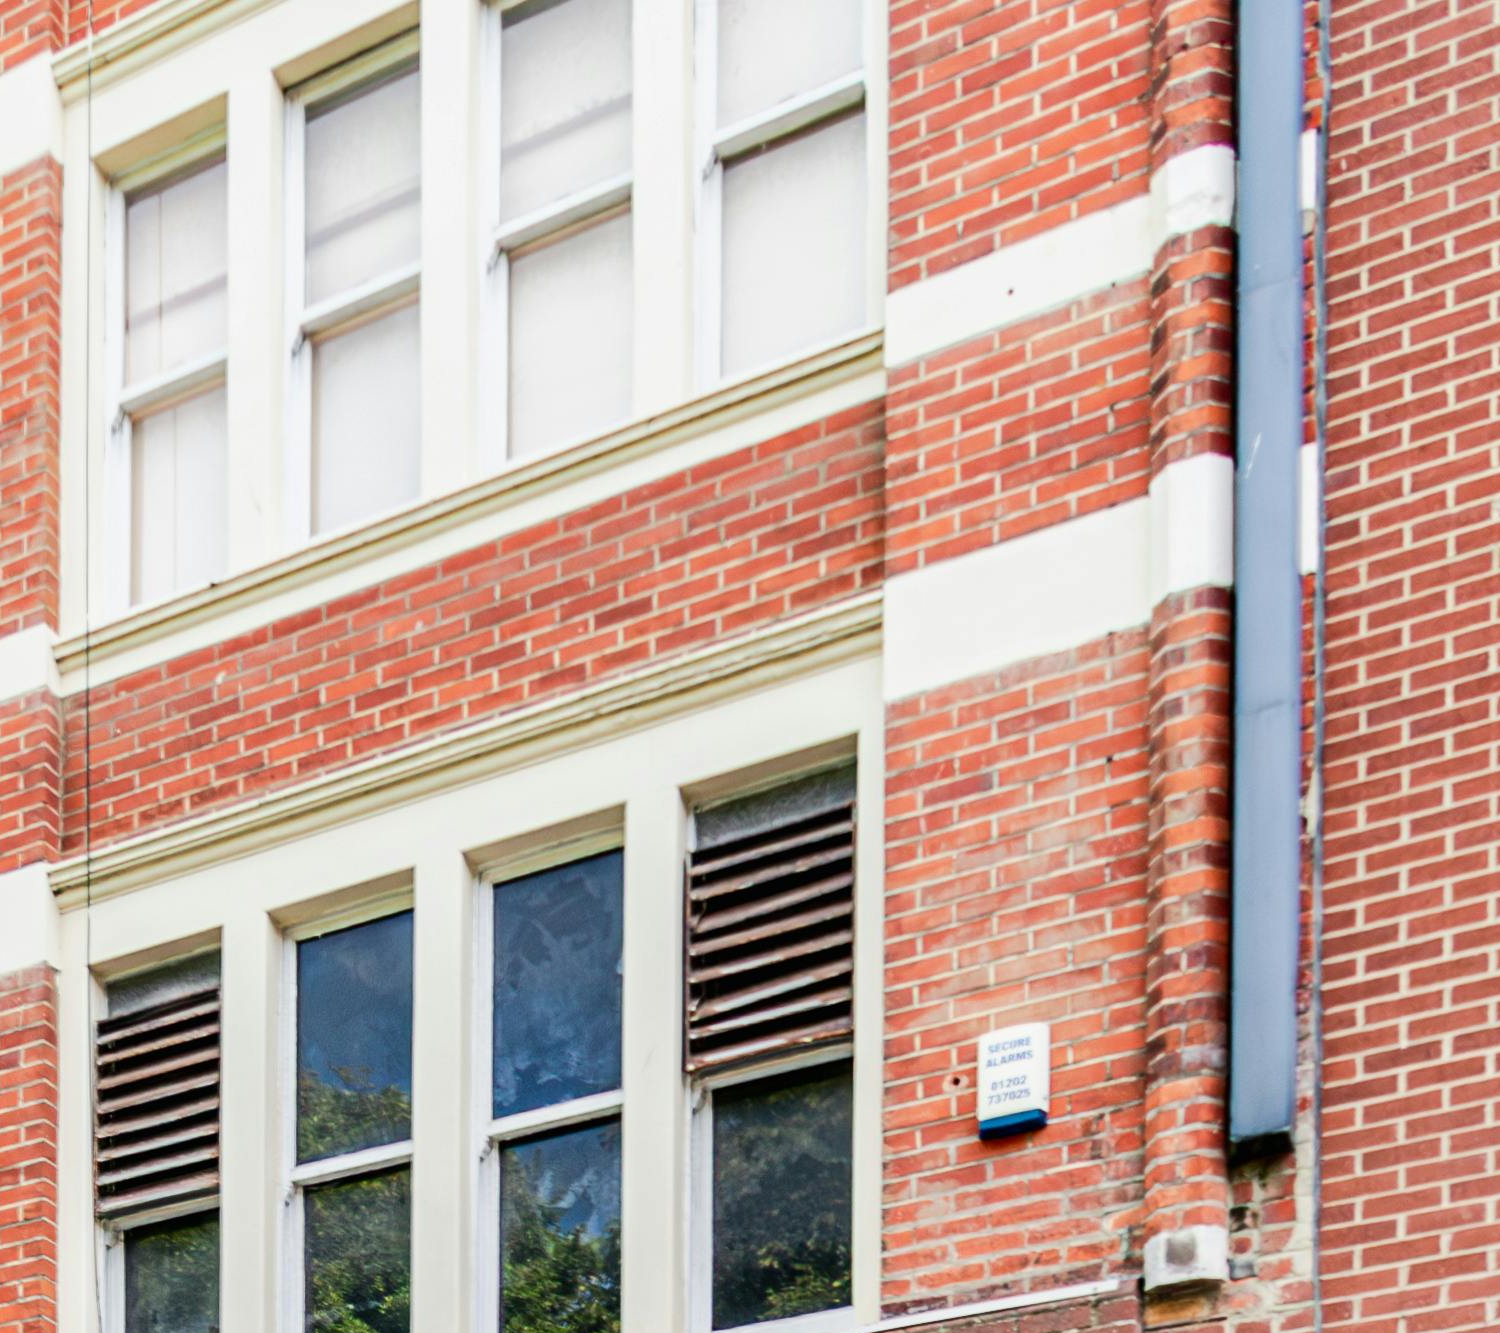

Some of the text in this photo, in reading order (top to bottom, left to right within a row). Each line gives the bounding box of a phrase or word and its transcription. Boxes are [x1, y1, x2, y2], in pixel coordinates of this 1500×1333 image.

[988, 1037, 1031, 1053] SECURE
[986, 1050, 1033, 1067] ALARMS
[991, 1075, 1027, 1091] 01202
